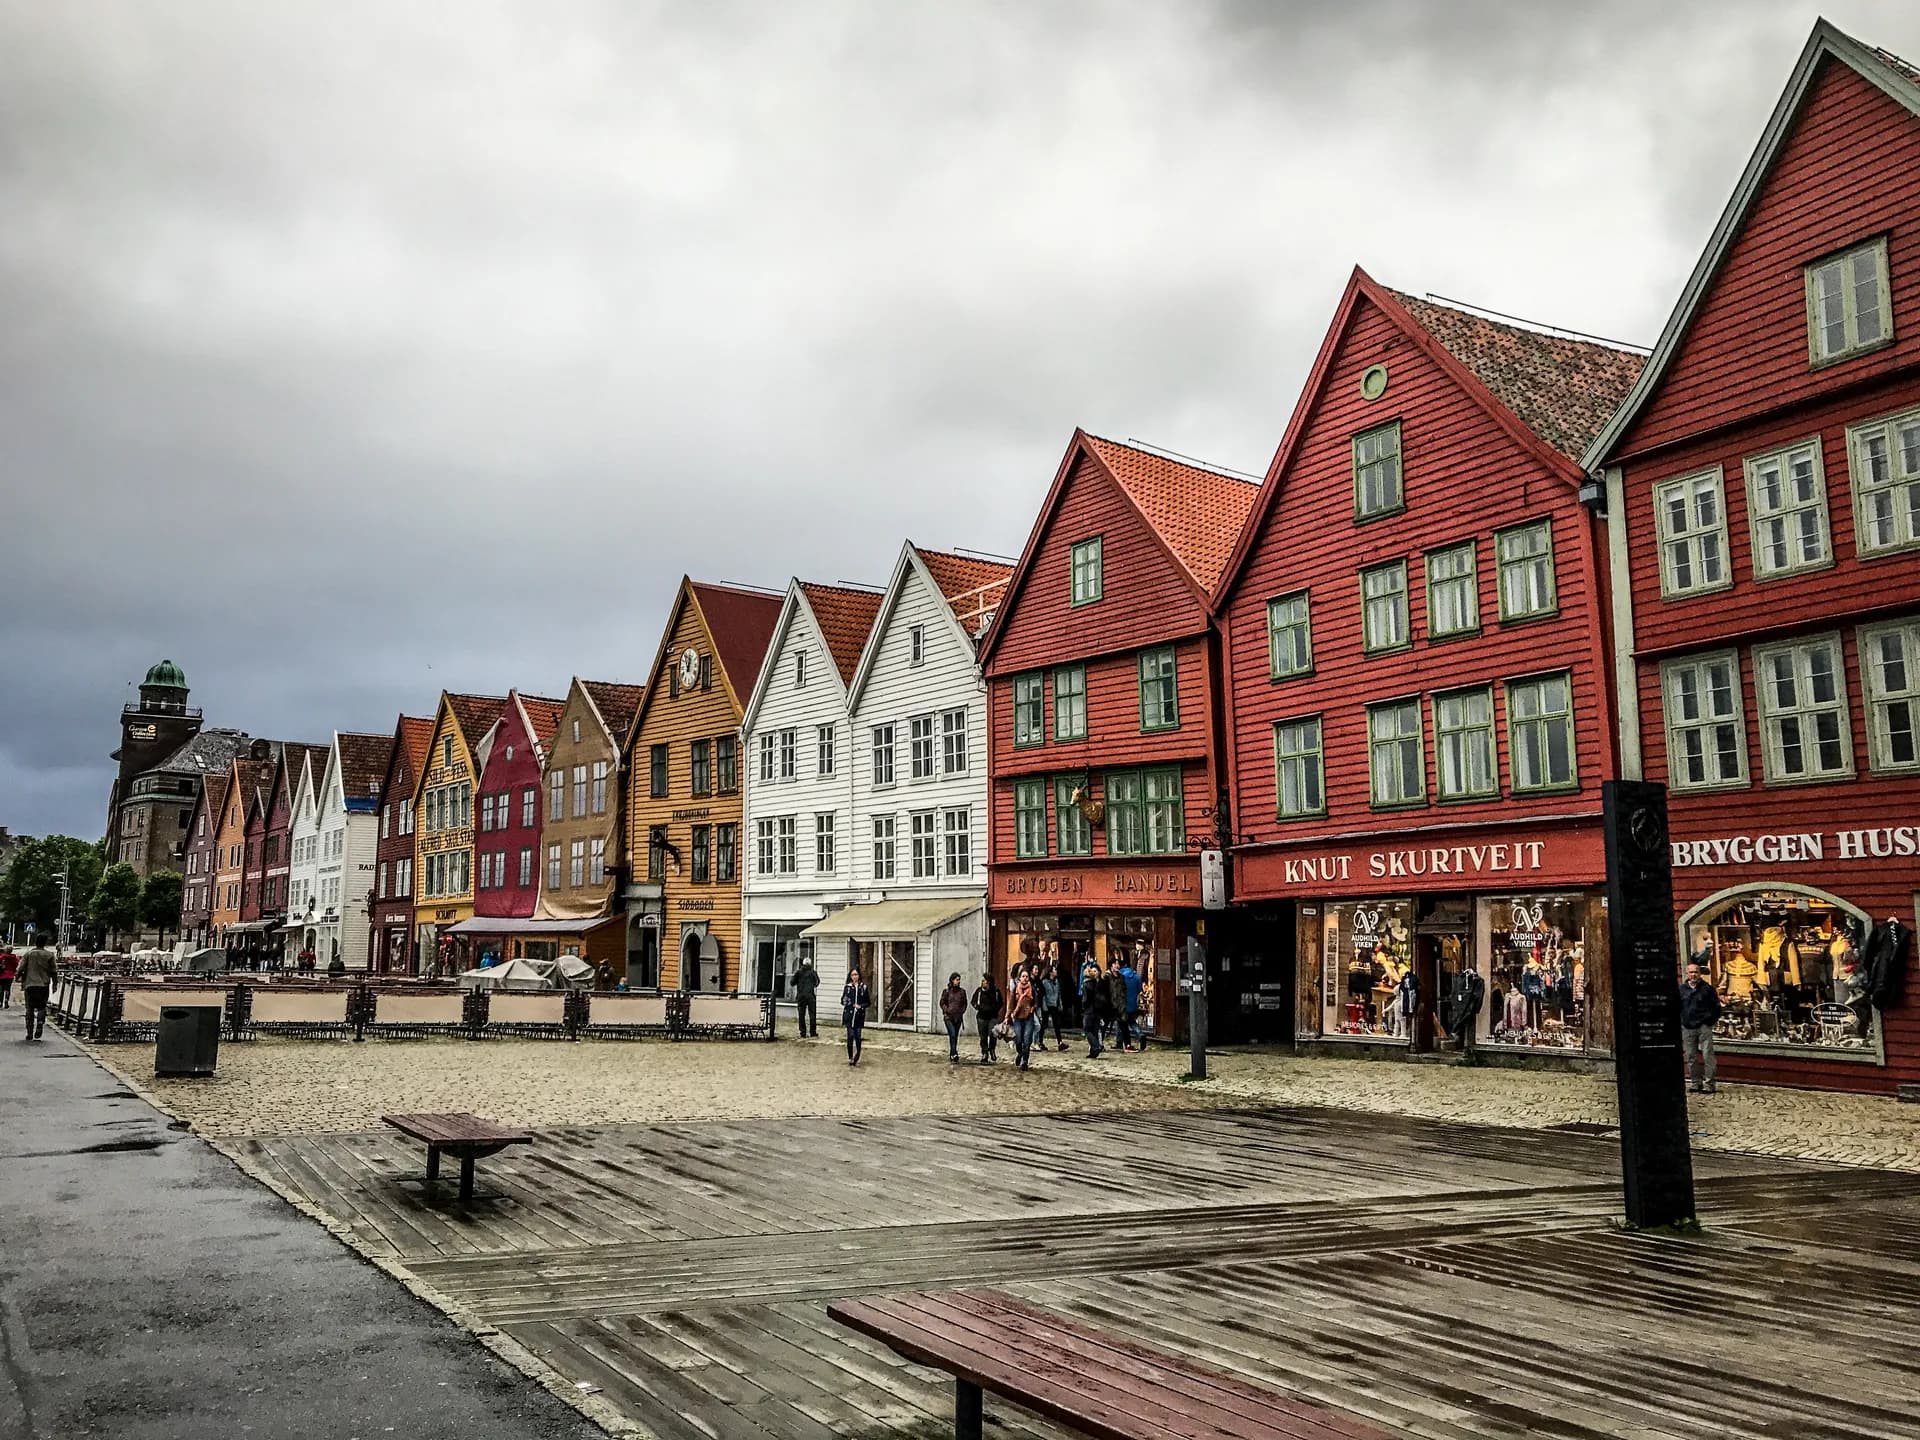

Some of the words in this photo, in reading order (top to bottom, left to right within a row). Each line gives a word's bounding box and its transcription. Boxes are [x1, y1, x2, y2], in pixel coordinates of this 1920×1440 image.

[1671, 832, 1823, 866] BRYGGEN
[1284, 856, 1353, 883] KNUT
[1369, 842, 1545, 877] SKURTVEIT
[1006, 875, 1084, 894] BRYGGEN
[1113, 872, 1193, 892] HANDEL
[1351, 934, 1378, 942] AUDHILD
[1509, 933, 1543, 941] AUDHILD
[1513, 940, 1537, 948] VIKEN
